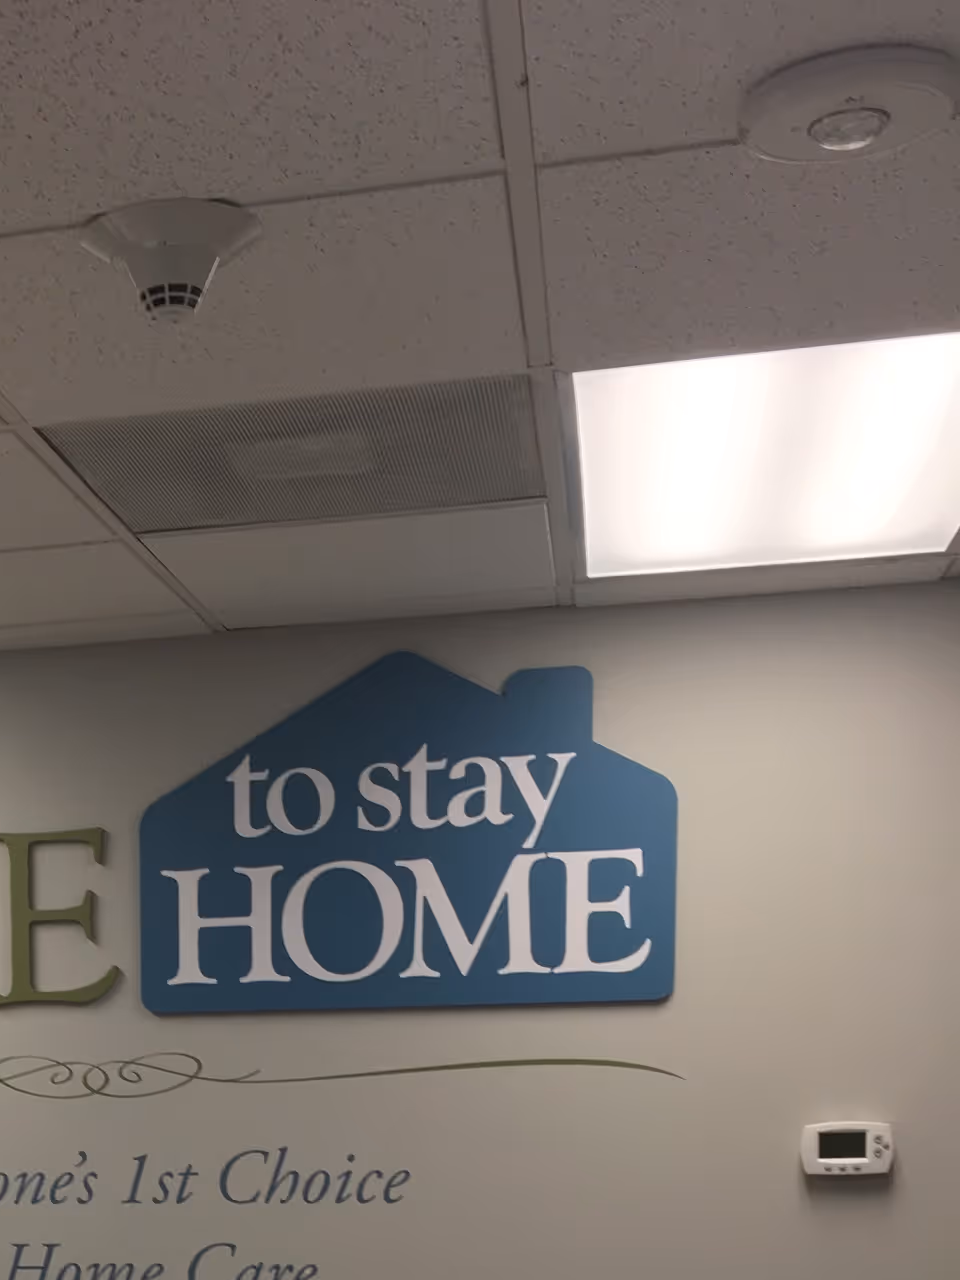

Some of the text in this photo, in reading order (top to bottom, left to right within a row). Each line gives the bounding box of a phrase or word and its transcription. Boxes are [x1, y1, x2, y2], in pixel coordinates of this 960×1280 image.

[226, 743, 577, 849] to stay
[160, 848, 653, 986] HOME
[121, 1152, 200, 1207] 1st
[217, 1147, 411, 1207] Choice
